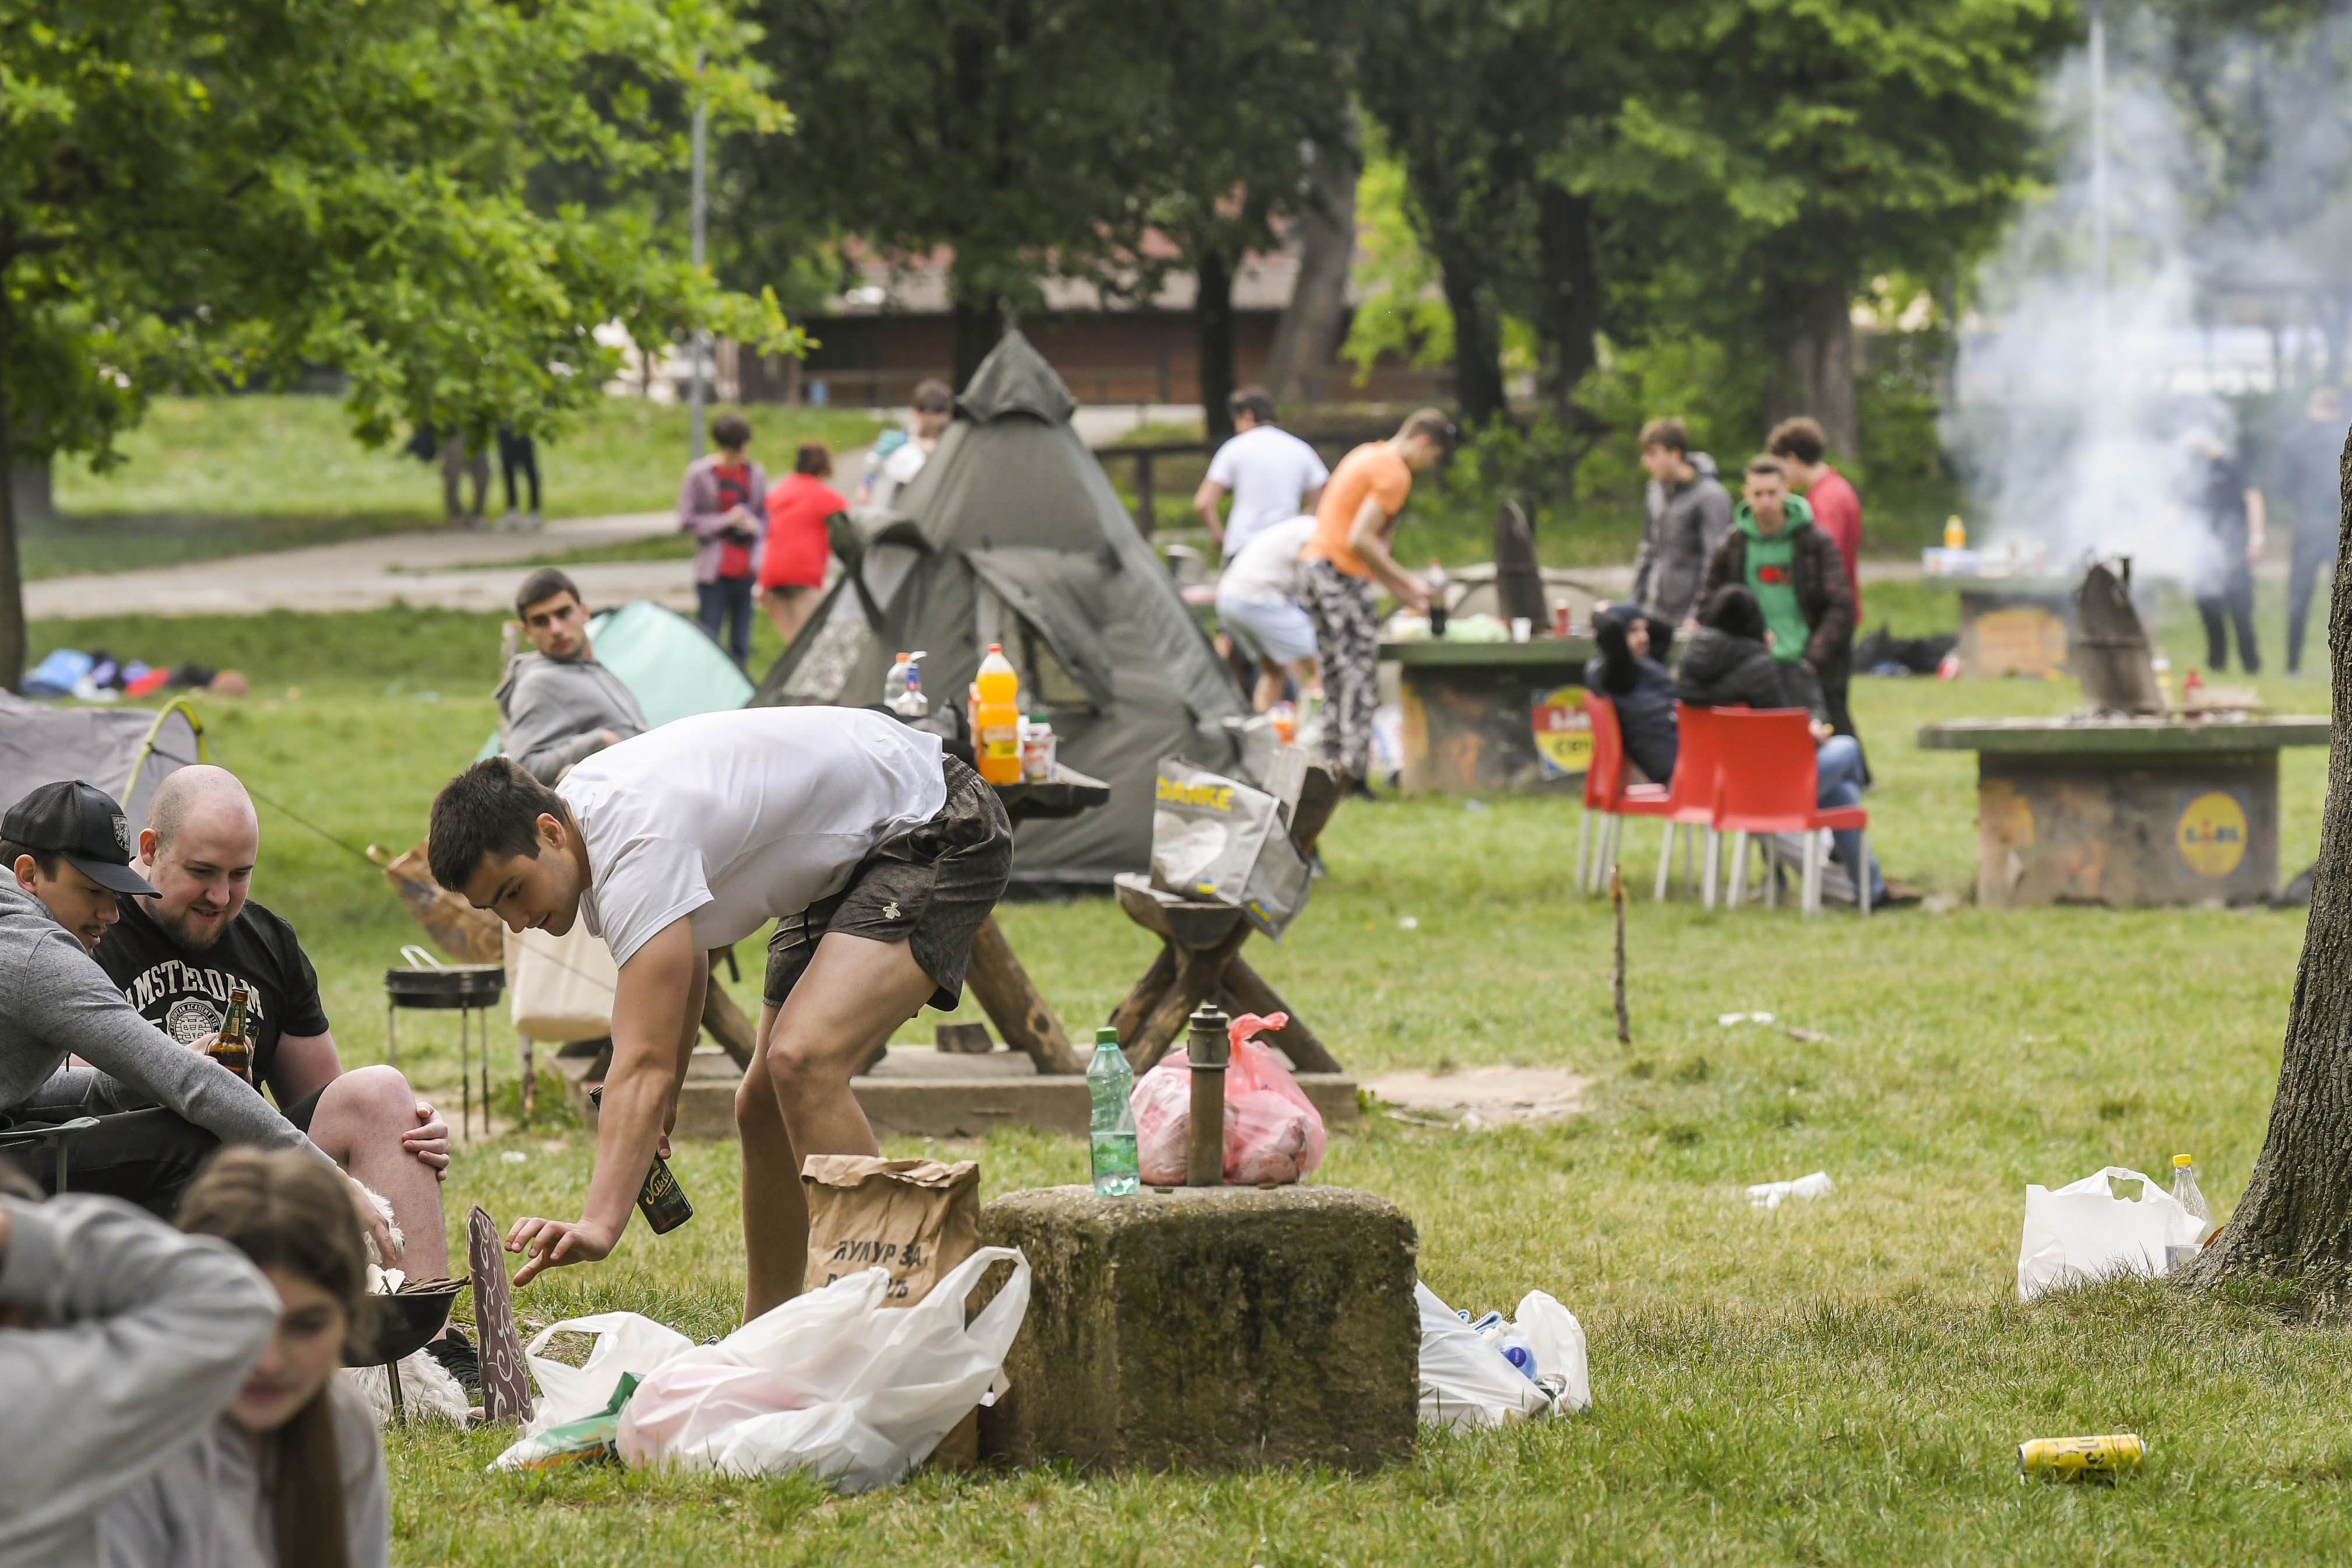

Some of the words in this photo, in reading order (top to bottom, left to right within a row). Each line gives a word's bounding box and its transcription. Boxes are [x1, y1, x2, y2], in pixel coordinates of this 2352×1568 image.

[1157, 777, 1234, 811] DANKE
[170, 1006, 186, 1029] EUROPEAN
[187, 1005, 212, 1017] ACADEMY
[899, 1244, 921, 1267] ЗА
